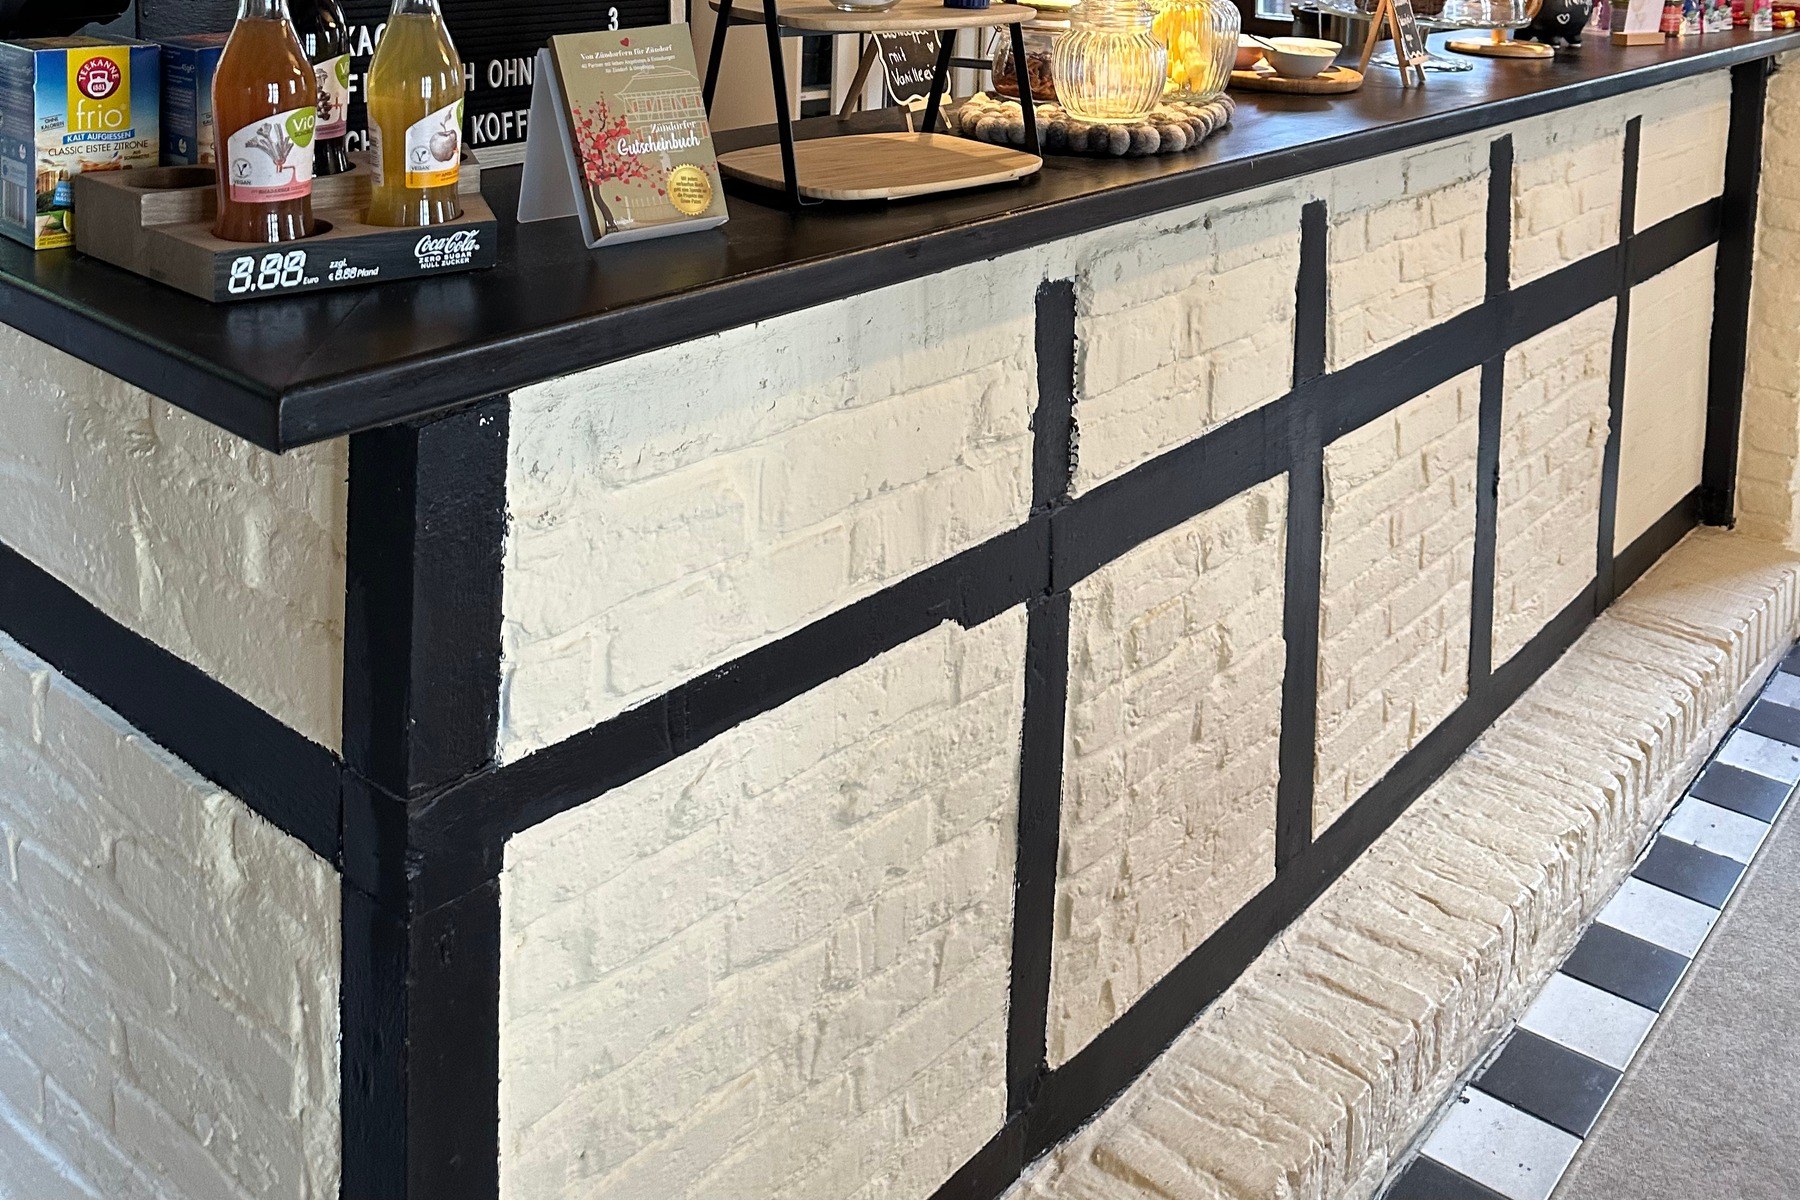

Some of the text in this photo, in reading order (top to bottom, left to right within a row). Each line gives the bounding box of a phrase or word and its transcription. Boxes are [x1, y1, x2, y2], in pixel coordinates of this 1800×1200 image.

[607, 6, 619, 31] 3
[78, 59, 120, 82] TEEKANNE
[488, 55, 536, 89] OHN
[77, 99, 123, 130] frio
[651, 120, 697, 133] Zündorfer
[67, 131, 131, 143] KALT AUFGIESSEN
[617, 129, 701, 156] Gutscheinbuch
[49, 140, 149, 156] CLASSIC EISTEE ZITRONE
[418, 251, 472, 264] ZERO SUGAR
[441, 257, 470, 267] ZUCKER
[357, 266, 379, 278] Pfand
[302, 276, 320, 285] Euro
